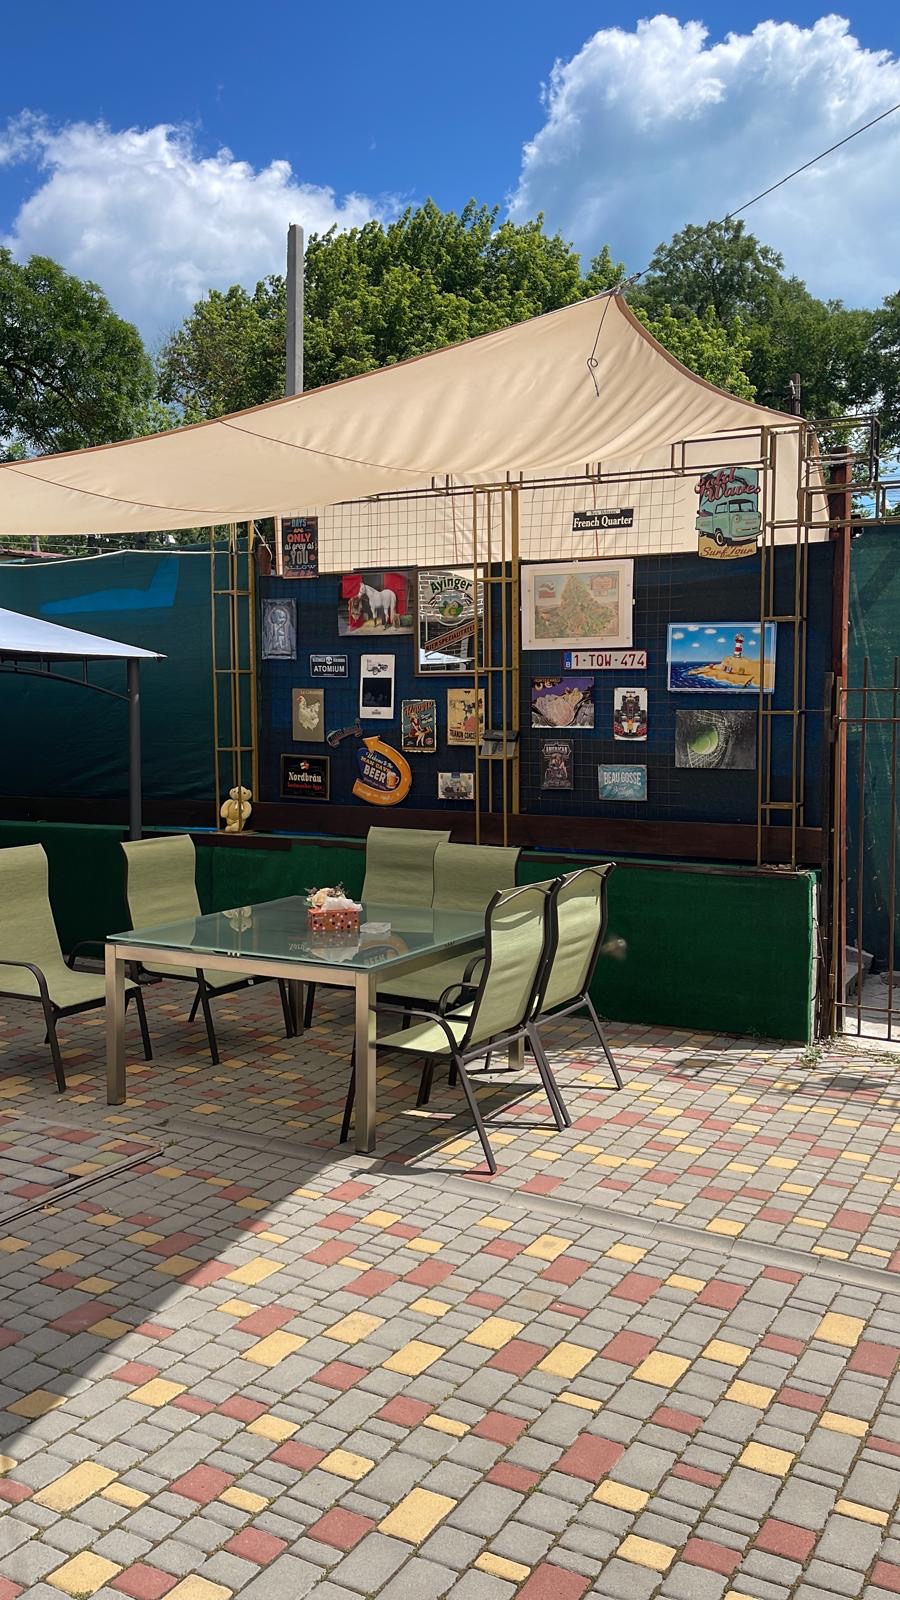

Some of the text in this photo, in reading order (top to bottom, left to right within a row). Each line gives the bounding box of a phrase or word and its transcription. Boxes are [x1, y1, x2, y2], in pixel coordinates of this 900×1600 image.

[291, 518, 307, 528] DAYS
[573, 515, 633, 528] French Quarter
[287, 533, 312, 543] ONLY
[290, 550, 309, 565] YOU
[702, 546, 728, 557] Surf
[430, 576, 473, 593] Ayinger
[313, 665, 345, 673] ATOMIUM
[288, 771, 322, 783] Nordbräu
[363, 764, 387, 784] BEER
[603, 771, 642, 787] BEAU GOSSE
